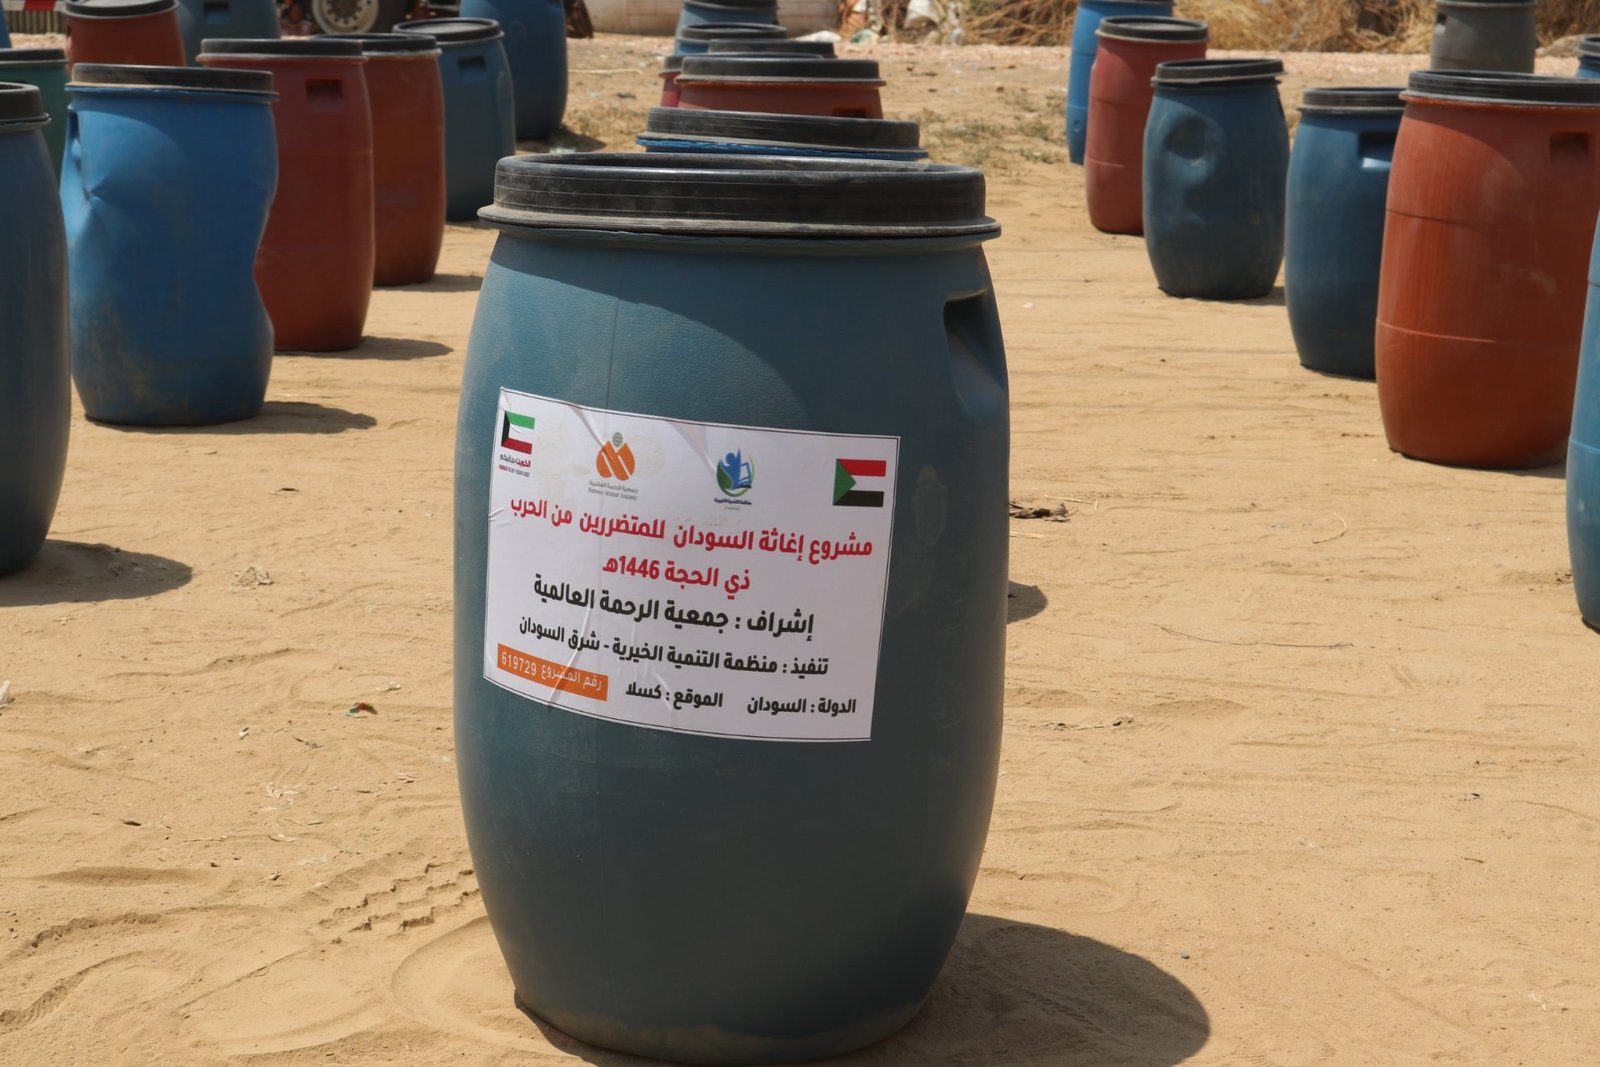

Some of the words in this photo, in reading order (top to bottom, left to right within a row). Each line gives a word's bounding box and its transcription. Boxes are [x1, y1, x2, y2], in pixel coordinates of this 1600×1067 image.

[511, 499, 548, 519] الحرب
[551, 504, 573, 527] من
[579, 512, 666, 539] للمتضررين
[673, 525, 754, 551] السودان
[758, 527, 804, 561] إغاثة
[809, 531, 873, 565] مشروع
[664, 560, 719, 590] الحجة
[724, 569, 750, 600] ذي
[533, 573, 595, 609] العالمية
[600, 589, 659, 622] الرحمة
[664, 600, 729, 634] جمعية
[519, 616, 565, 643] السودان
[747, 608, 814, 642] إشراف
[568, 629, 600, 652] شرق
[612, 637, 663, 663] الخيرية
[501, 651, 537, 677] 619729
[667, 644, 720, 669] التنمية
[723, 652, 778, 674] منظمة
[790, 657, 829, 679] تنفيذ
[582, 674, 602, 691] رقم
[625, 682, 662, 701] كسلا
[672, 688, 723, 710] الموقع
[747, 697, 807, 716] السودان
[817, 698, 857, 717] الدولة
